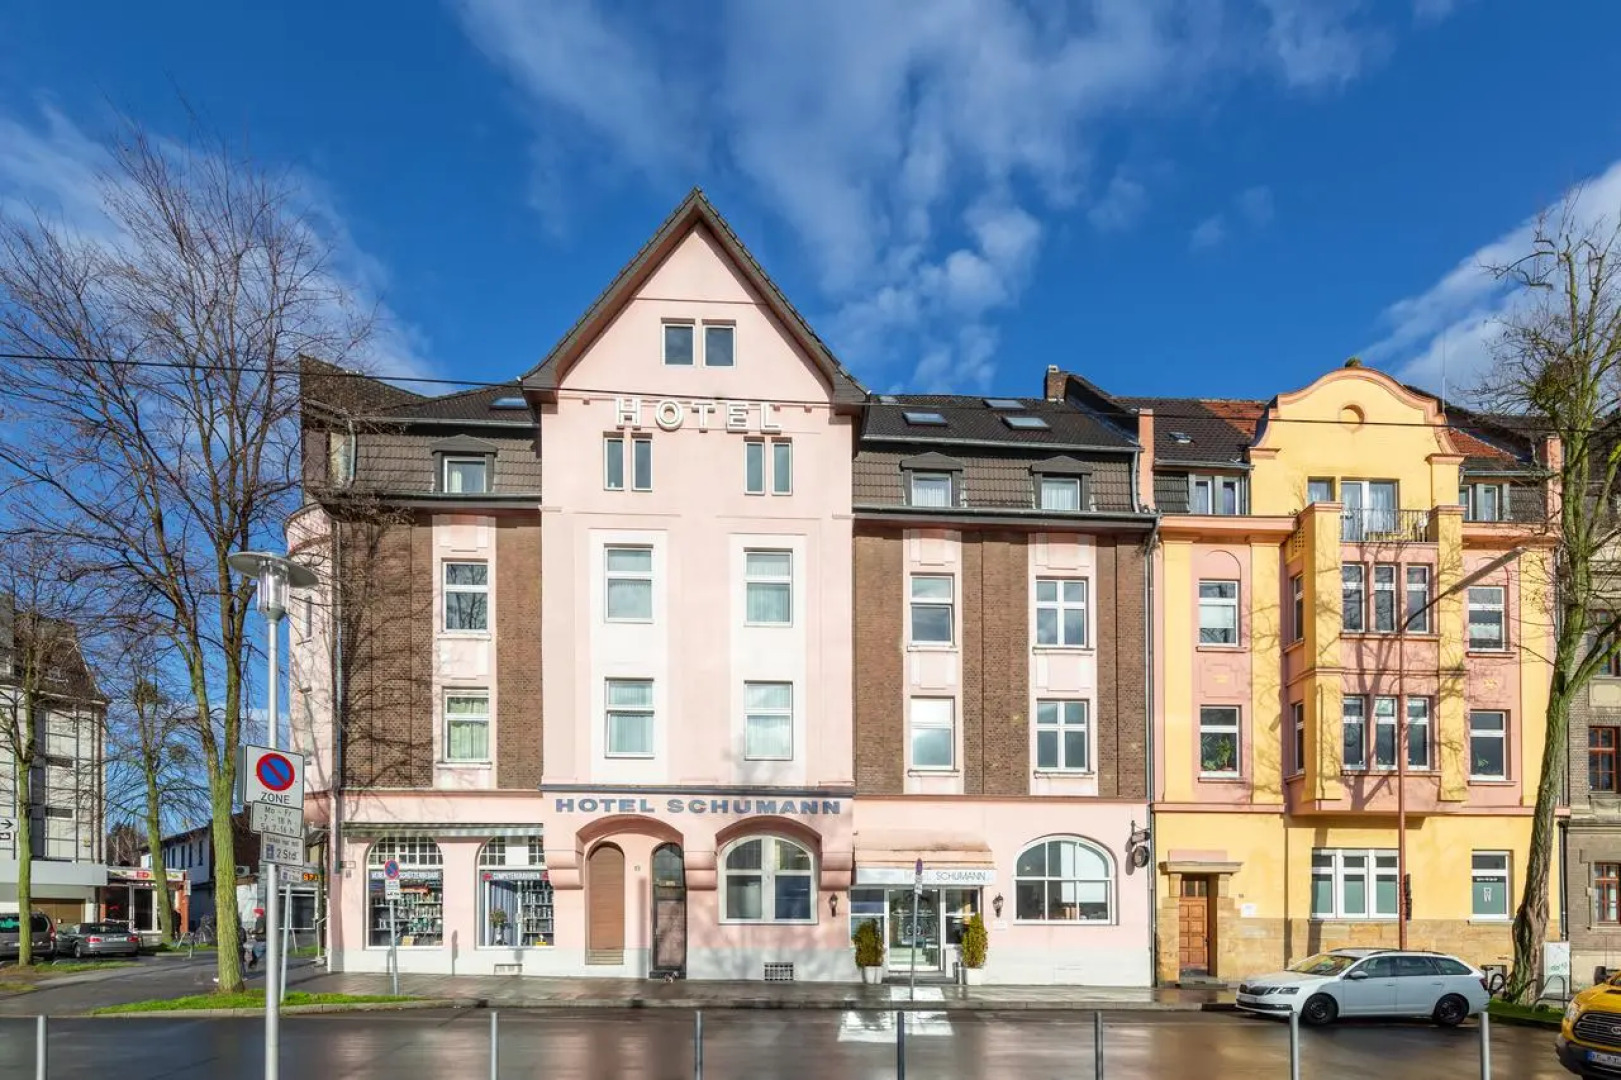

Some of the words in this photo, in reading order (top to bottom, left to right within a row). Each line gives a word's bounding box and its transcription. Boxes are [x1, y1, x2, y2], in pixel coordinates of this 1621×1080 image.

[615, 396, 782, 434] HOTEL
[260, 791, 291, 804] ZONE
[264, 805, 276, 814] Mo
[555, 798, 655, 814] HOTEL
[666, 798, 841, 815] SCHUMANN
[935, 870, 986, 881] SCHUMANN
